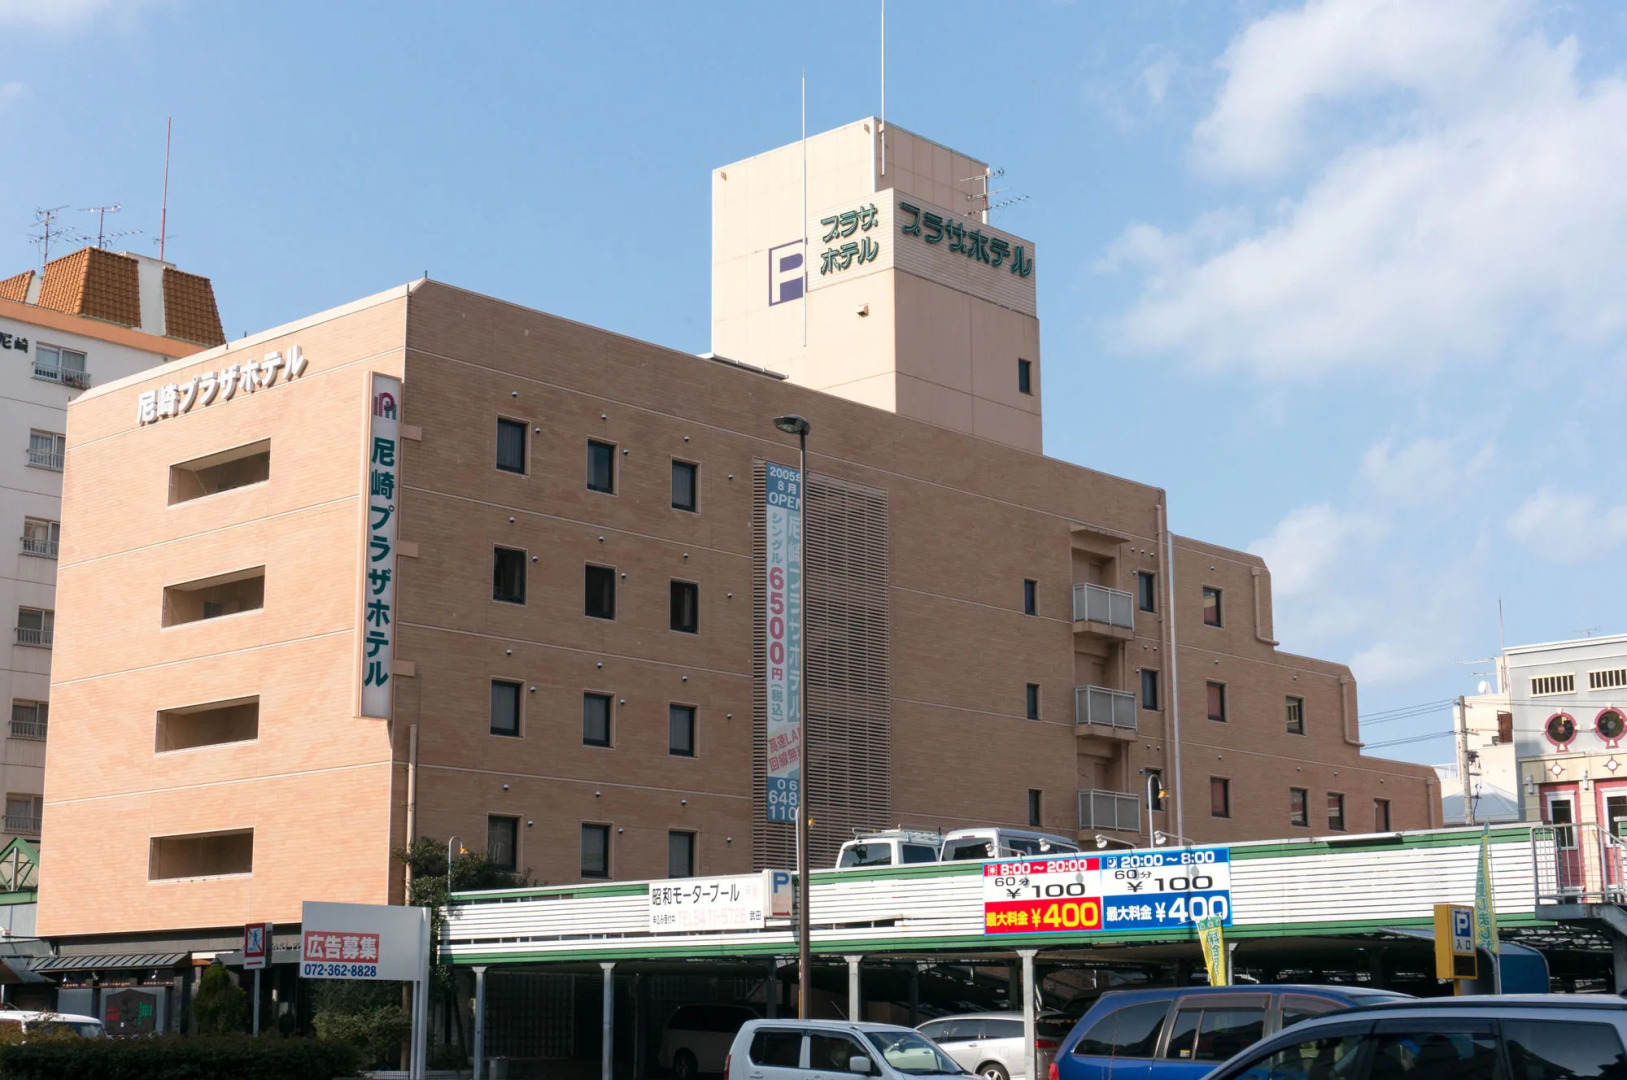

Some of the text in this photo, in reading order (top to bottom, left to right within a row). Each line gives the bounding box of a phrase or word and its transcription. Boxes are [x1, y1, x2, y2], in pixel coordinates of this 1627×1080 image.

[820, 203, 879, 243] プラザ
[899, 201, 1033, 277] プラザホテル
[820, 236, 879, 276] ホテル
[137, 345, 308, 426] 尼崎プラザホテル
[777, 480, 797, 494] 8月
[364, 436, 396, 687] 尼崎プラザホテル
[777, 779, 798, 791] 06
[768, 790, 801, 806] 648
[773, 872, 789, 893] P
[994, 876, 1031, 888] 60分
[1114, 869, 1153, 880] 60分
[651, 883, 741, 906] 昭和モータープール
[986, 901, 1099, 928] 最大料金 ¥400
[1106, 904, 1153, 922] 最大料金
[1154, 895, 1229, 924] ¥400
[1454, 910, 1471, 938] P
[306, 934, 377, 960] 広告募集
[1456, 938, 1471, 951] 入口
[304, 963, 377, 977] 072-362-8828
